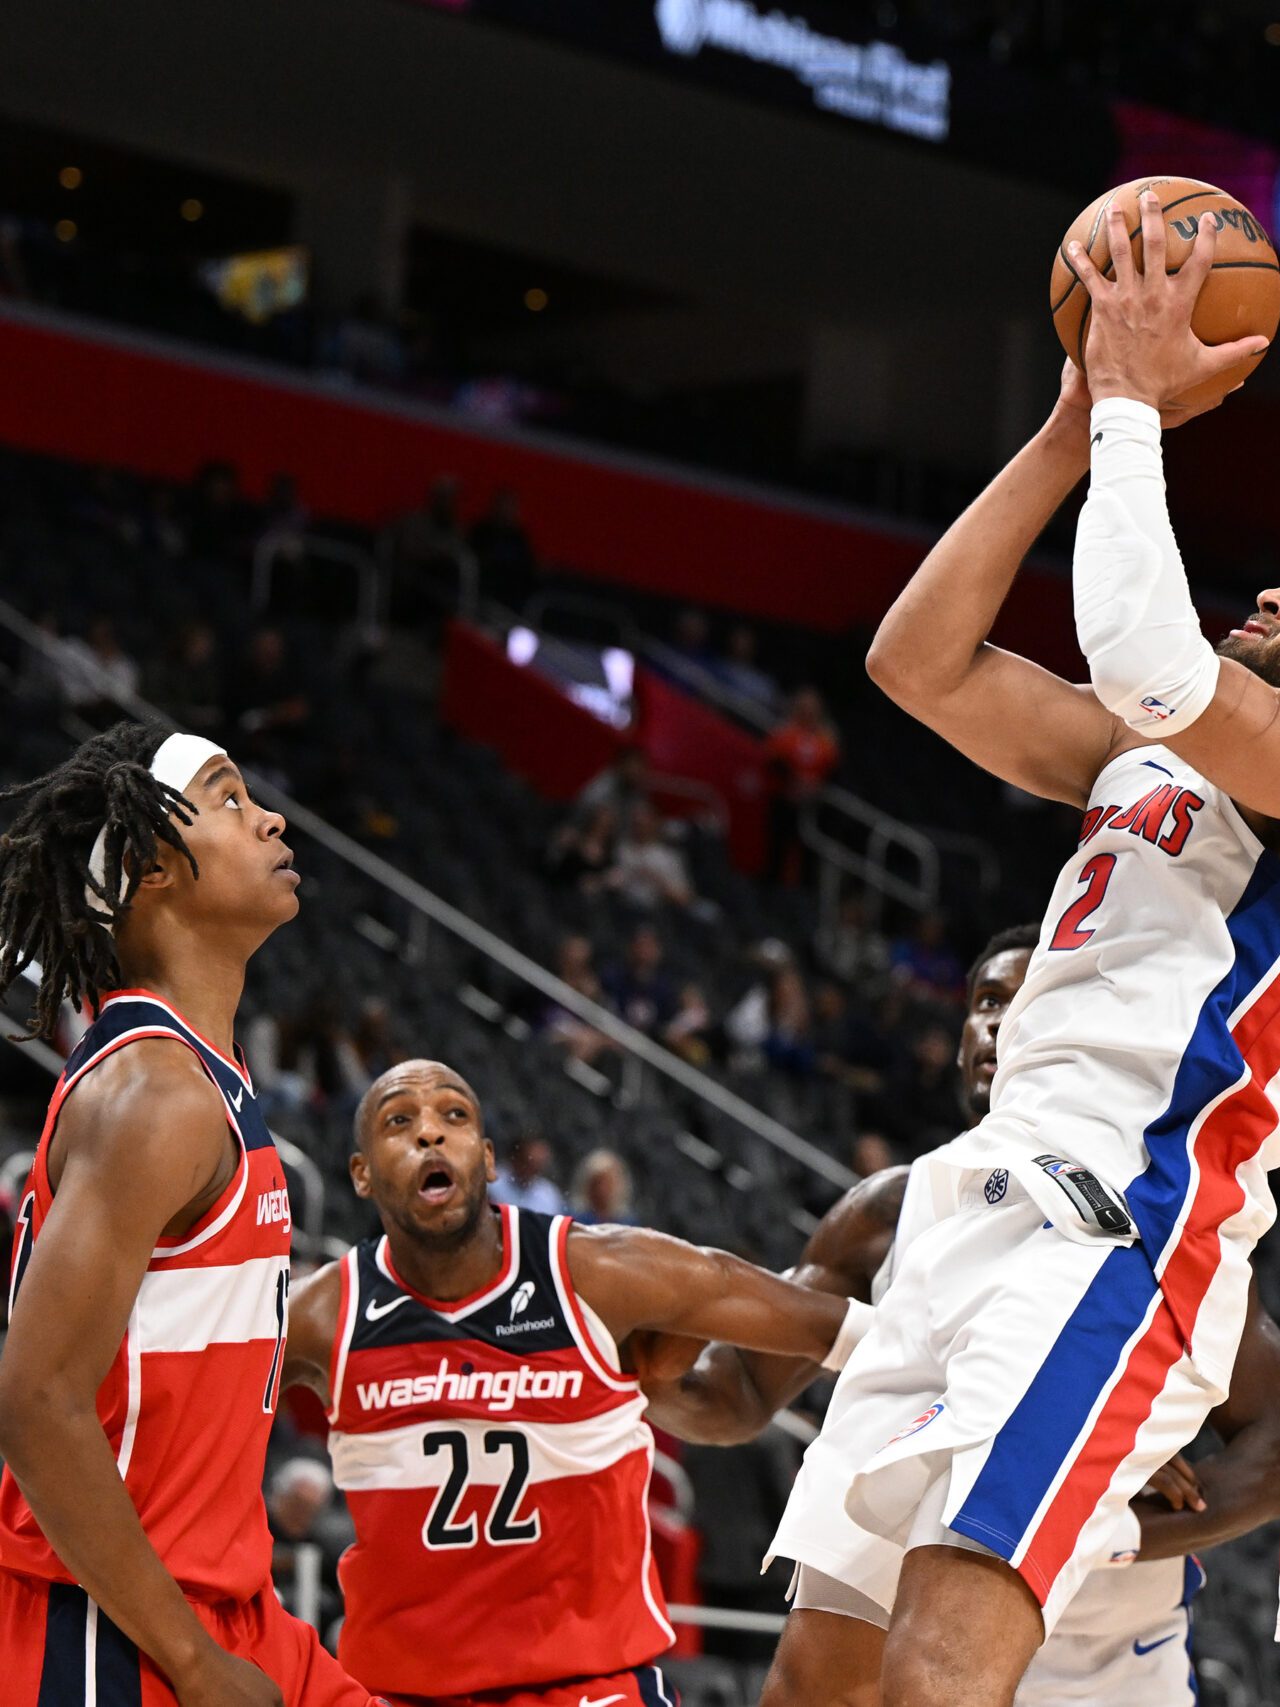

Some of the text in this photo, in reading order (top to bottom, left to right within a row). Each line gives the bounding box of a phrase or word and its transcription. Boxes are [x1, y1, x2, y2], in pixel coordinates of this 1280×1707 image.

[1048, 852, 1117, 950] 2
[495, 1316, 555, 1338] Robinhood
[356, 1357, 584, 1412] washington
[421, 1430, 542, 1551] 22
